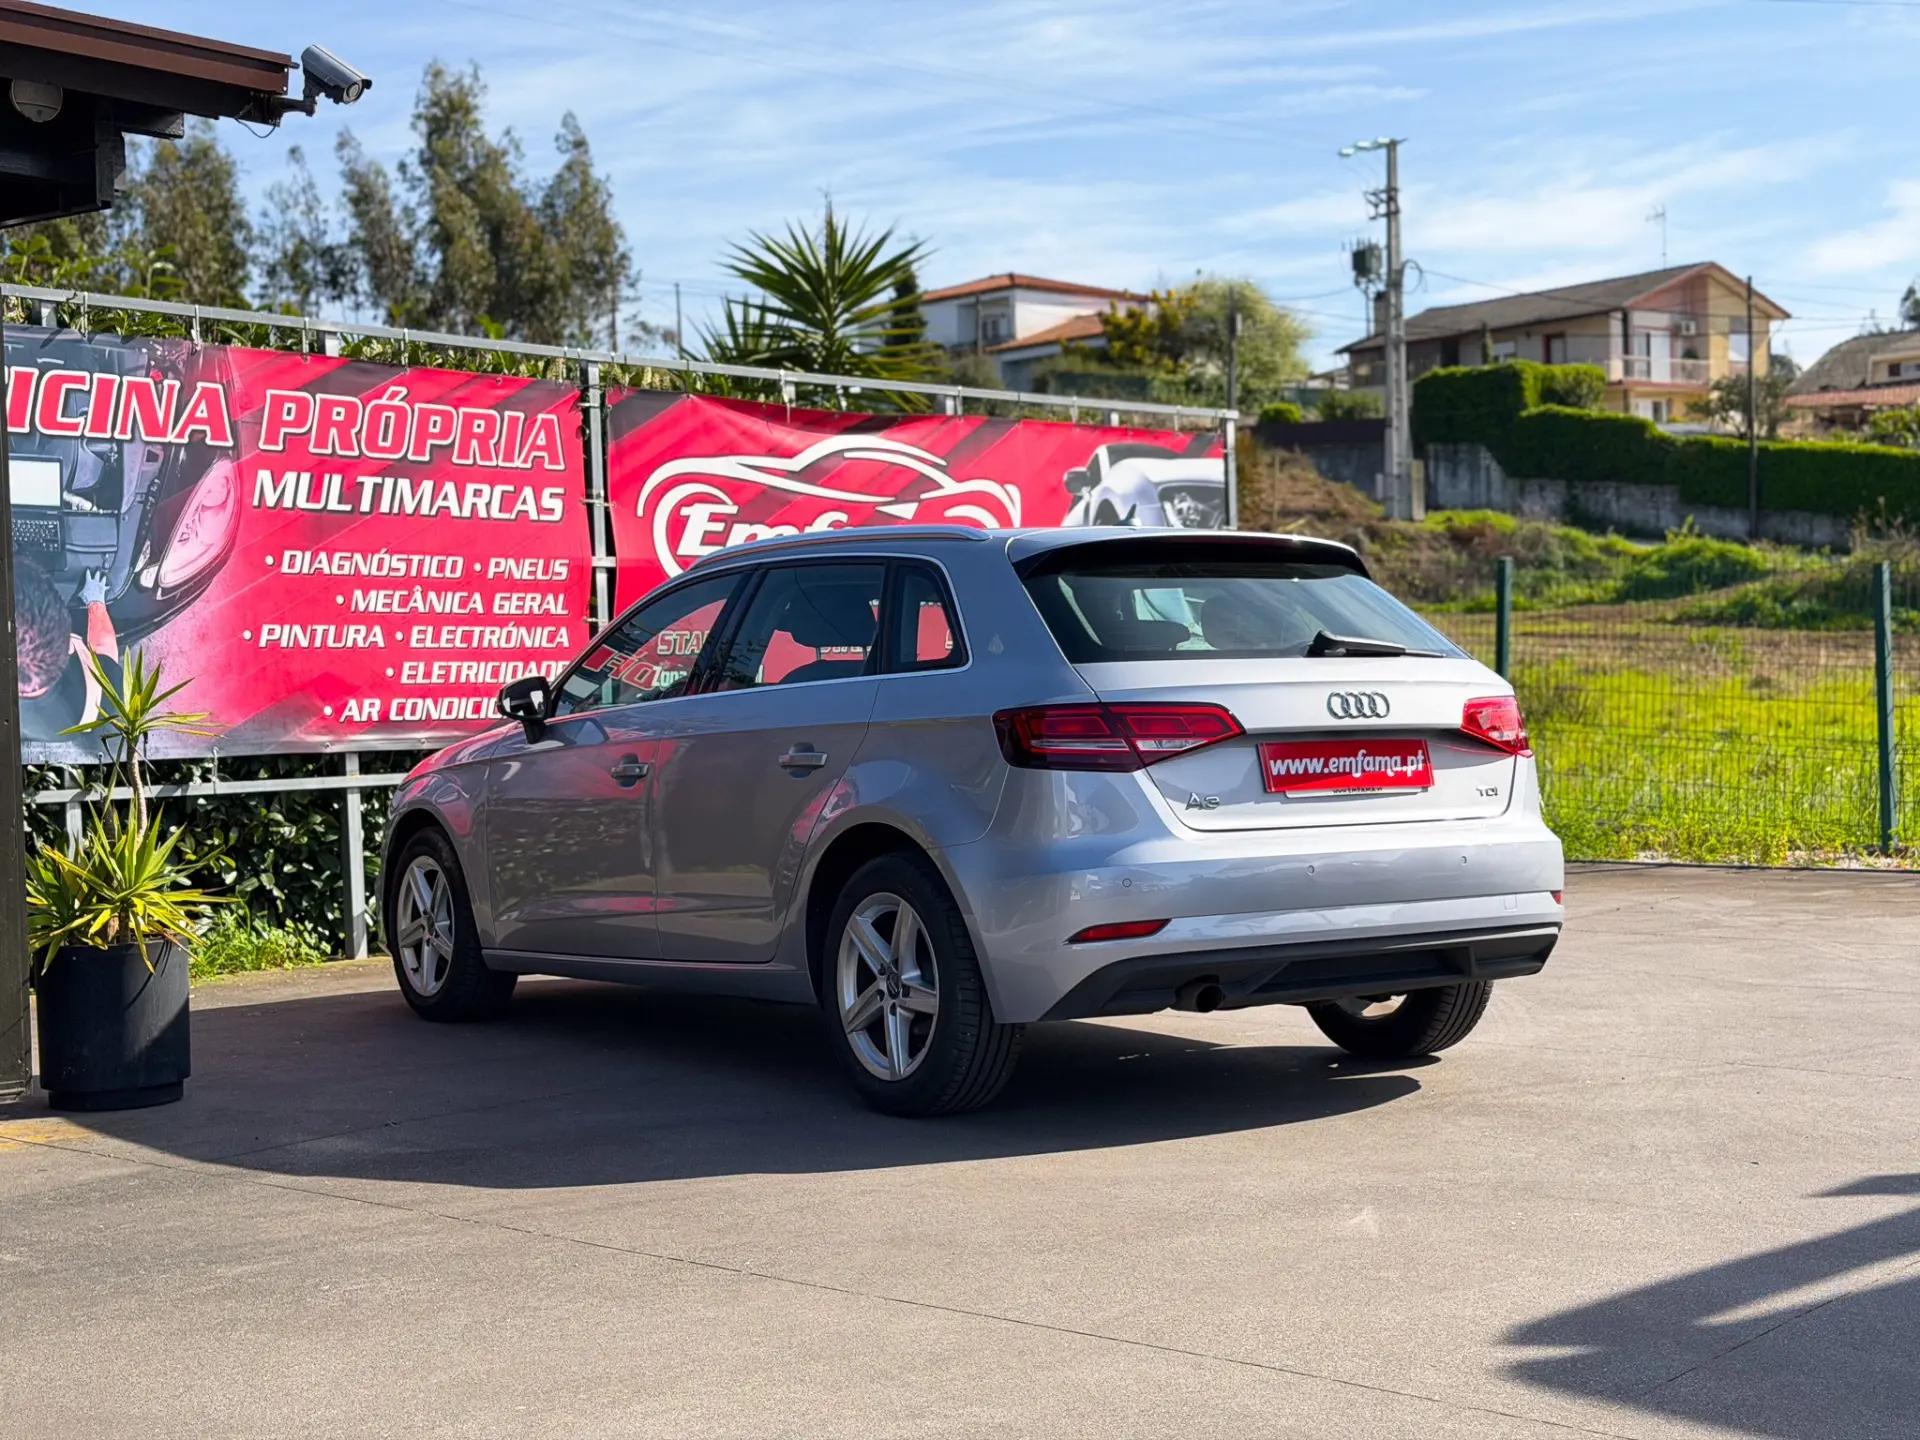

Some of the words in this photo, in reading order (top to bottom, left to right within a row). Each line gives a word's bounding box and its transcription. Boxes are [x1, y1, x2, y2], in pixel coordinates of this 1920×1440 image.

[4, 366, 233, 447] ICINA
[258, 385, 566, 470] PRÓPRIA
[253, 469, 565, 522] MULTIMARCAS
[281, 549, 464, 579] DIAGNÓSTICO
[488, 558, 569, 581] PNEUS
[351, 585, 484, 615] MECÂNICA
[493, 593, 569, 615] GERAL
[259, 624, 386, 649] PINTURA
[409, 622, 569, 649] ELECTRÓNICA
[657, 631, 710, 655] STA
[339, 698, 382, 723] AR
[1269, 749, 1425, 778] www.emfama.pt
[1185, 791, 1220, 811] A3
